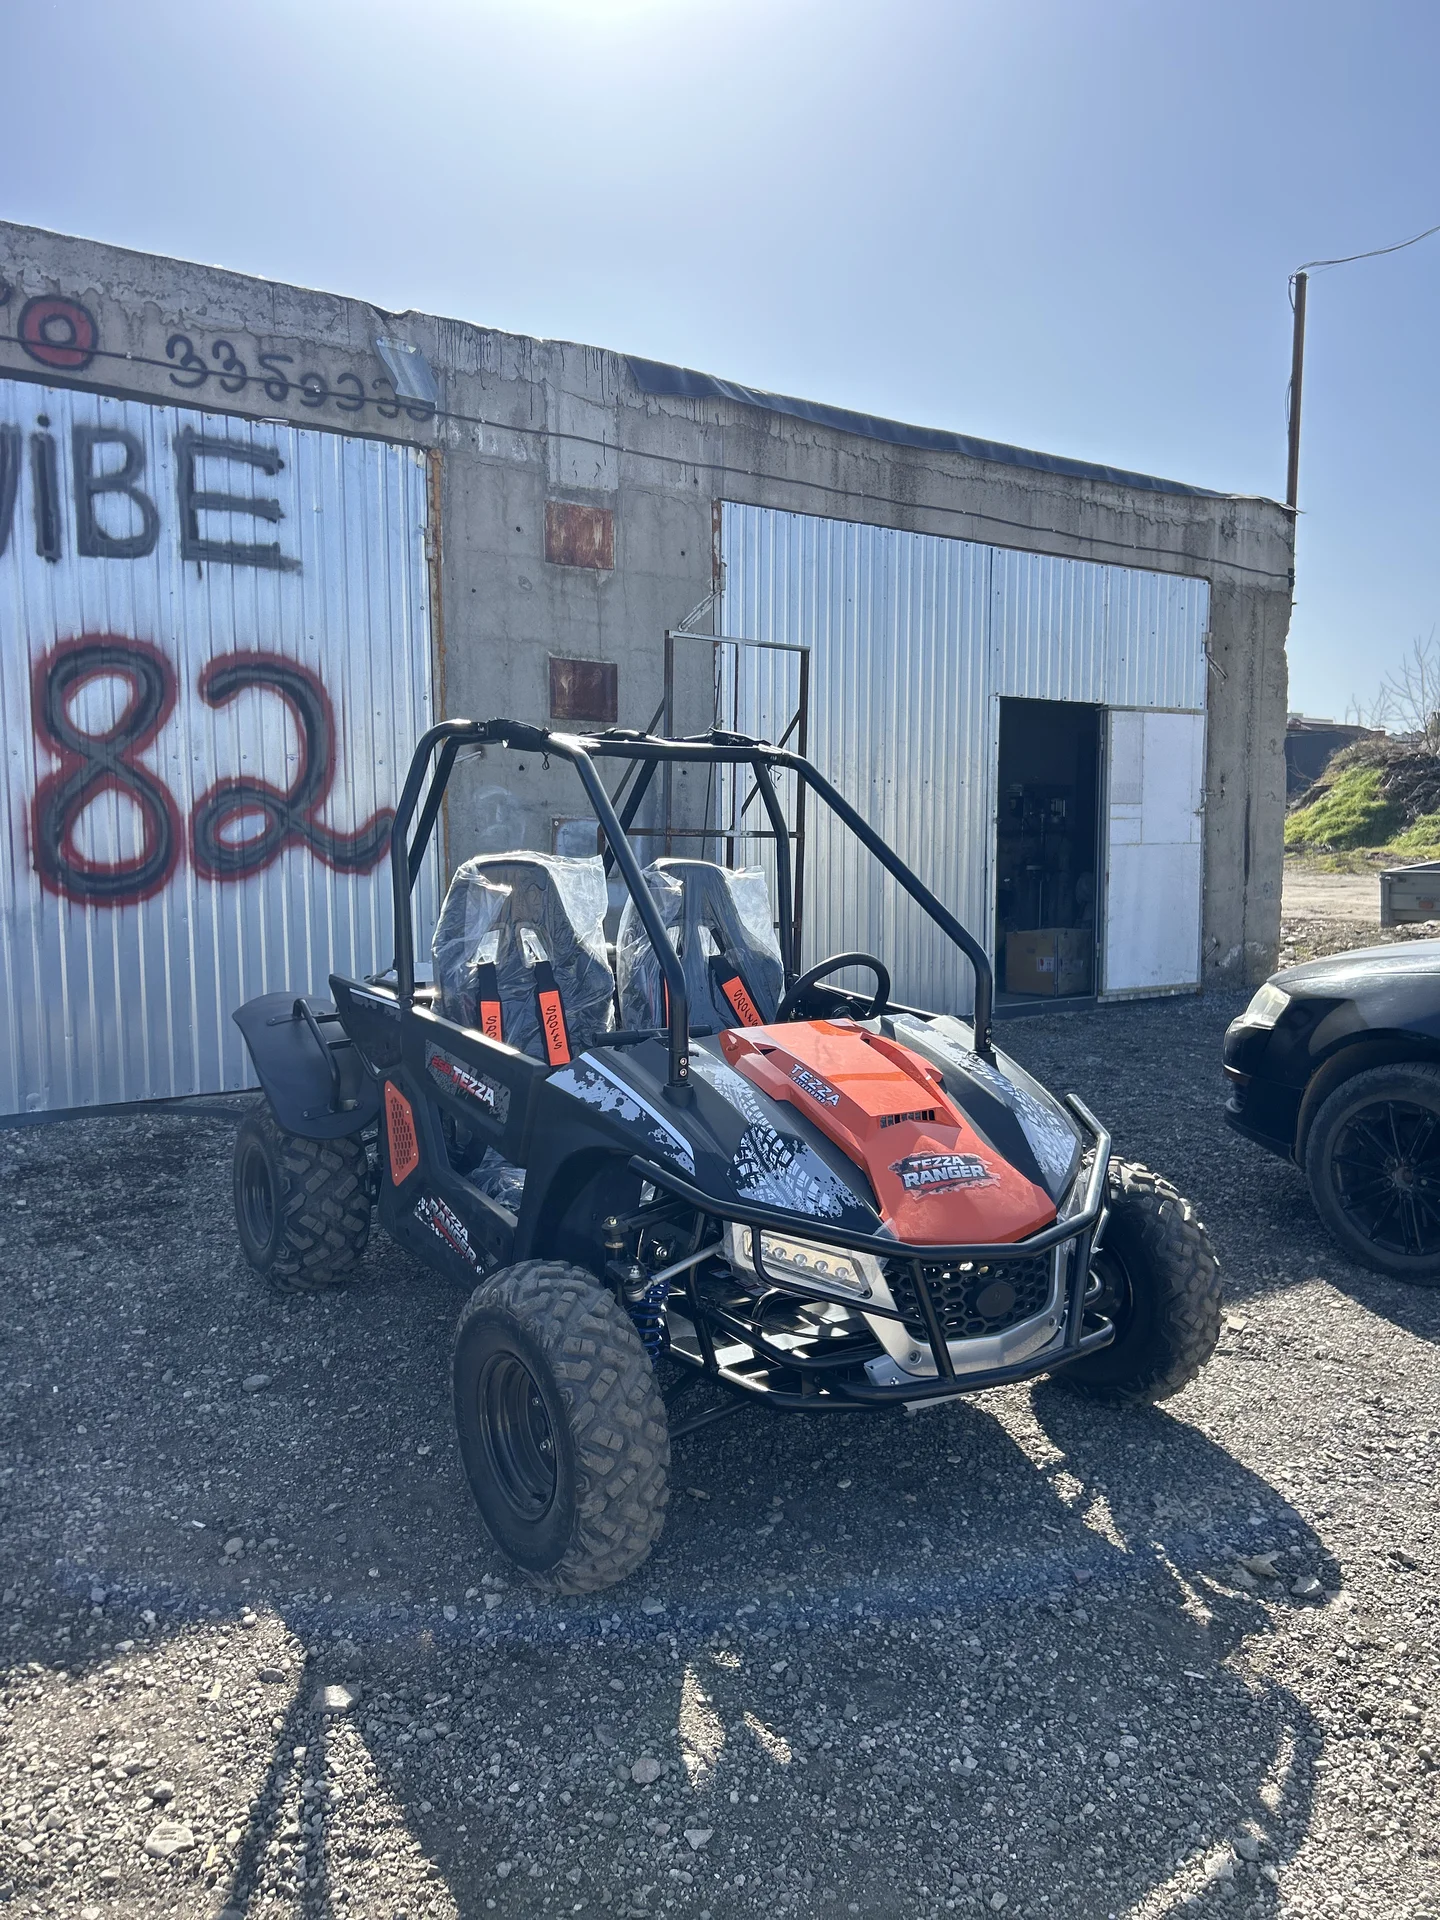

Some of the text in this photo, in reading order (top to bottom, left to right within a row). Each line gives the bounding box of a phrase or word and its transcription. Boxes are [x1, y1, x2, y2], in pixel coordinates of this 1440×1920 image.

[31, 633, 396, 908] 82
[486, 1016, 498, 1038] Spo
[546, 1005, 562, 1050] Sports
[452, 1065, 494, 1106] TEZZA
[791, 1063, 840, 1106] TEZZA
[903, 1165, 985, 1188] RANGER
[908, 1156, 965, 1170] TEZZA
[428, 1197, 477, 1265] RANGER
[438, 1197, 468, 1241] TEZZA
